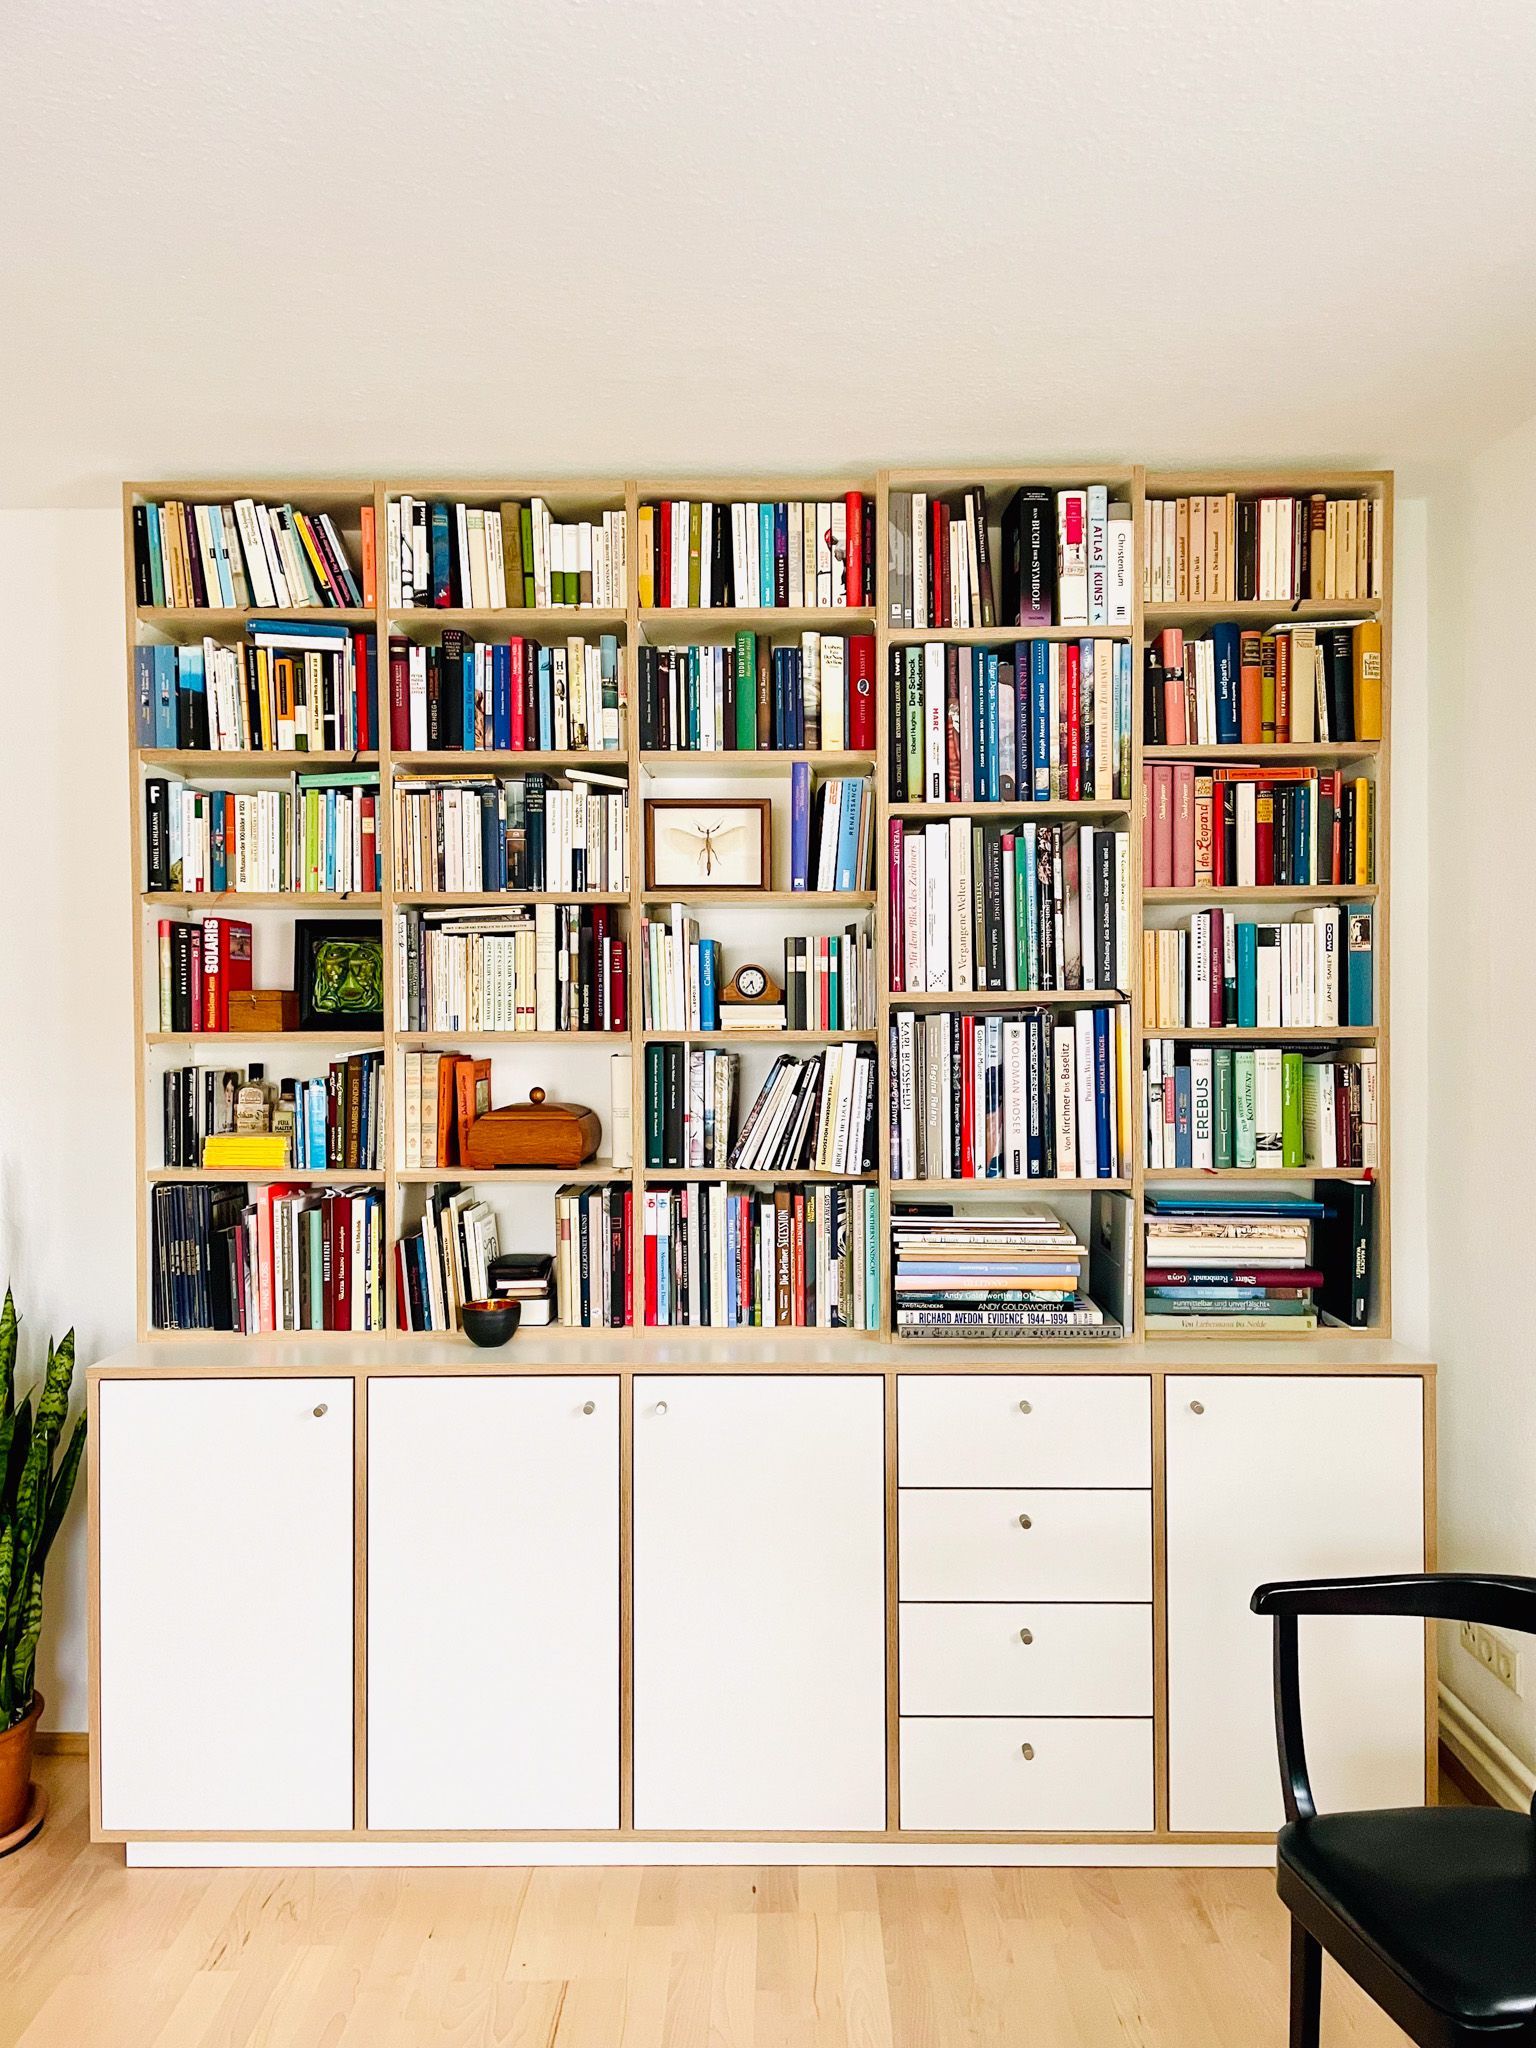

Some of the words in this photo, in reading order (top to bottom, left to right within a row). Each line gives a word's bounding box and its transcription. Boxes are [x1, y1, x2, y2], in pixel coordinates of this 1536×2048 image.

[977, 516, 986, 563] PORTRÄTMALEREI
[1031, 520, 1040, 549] BUCH
[1094, 526, 1103, 561] ATLAS
[1117, 533, 1125, 587] Christentum
[1031, 561, 1040, 611] SYMBOLE
[1094, 572, 1103, 607] KUNST
[989, 661, 997, 680] Edgar
[1019, 655, 1027, 701] TURNER
[1099, 654, 1108, 704] ZEICHENKUNST
[1220, 659, 1229, 699] Landpartie
[910, 710, 918, 734] Hughes
[1020, 702, 1027, 710] IN
[1099, 707, 1108, 719] DER
[1020, 713, 1028, 770] DEUTSCHLAND
[849, 783, 857, 836] RENAISSANCE
[1159, 784, 1168, 820] Shakespeare
[1181, 783, 1190, 820] Shakespeare
[1195, 803, 1212, 852] Leopard
[893, 829, 901, 866] VERMEER
[1196, 853, 1210, 867] der
[908, 845, 917, 887] Zeichners
[908, 888, 917, 903] des
[956, 878, 966, 912] Welten
[976, 881, 984, 923] STILLEBEN
[908, 905, 918, 928] Blick
[203, 920, 219, 974] SOLARIS
[909, 930, 918, 949] dem
[957, 914, 969, 969] Vergangene
[909, 950, 919, 969] Mit
[207, 977, 215, 992] Lem
[207, 992, 215, 1029] Stanislaw
[901, 1021, 910, 1047] KARL
[868, 1059, 876, 1079] Edward
[891, 1035, 899, 1077] Goldsworthy
[1011, 1040, 1019, 1095] KOLOMAN
[1060, 1043, 1070, 1080] Baselitz
[902, 1052, 911, 1110] BLOSSFELDT
[930, 1063, 939, 1093] Regina
[824, 1097, 832, 1126] MODERNEN
[930, 1095, 939, 1127] Relang
[1196, 1078, 1209, 1140] EREBUS
[1237, 1095, 1245, 1119] WEISSE
[1245, 1071, 1254, 1121] KONTINENT
[351, 1105, 359, 1134] BAMBIS
[1012, 1097, 1021, 1135] MOSER
[1062, 1094, 1071, 1135] Kirchner
[1241, 1119, 1249, 1133] DER
[821, 1127, 829, 1166] HOLZSCHNITTS
[776, 1209, 790, 1248] SECESSION
[581, 1235, 589, 1279] GEZEICHNETE
[779, 1248, 789, 1275] Berliner
[261, 1262, 269, 1288] KLOSS
[779, 1275, 789, 1285] Die
[1167, 1273, 1187, 1284] Goya
[1192, 1275, 1229, 1284] Rembrandt
[1235, 1275, 1257, 1285] Dürer
[261, 1289, 269, 1311] HANS
[944, 1292, 965, 1300] Andy
[966, 1292, 1013, 1300] Goldsworthy
[977, 1303, 1001, 1311] ANDY
[1001, 1303, 1065, 1312] GOLDSWORTHY
[918, 1313, 951, 1324] RICHARD
[953, 1312, 984, 1324] AVEDON
[987, 1312, 1024, 1324] EVIDENCE
[1181, 1320, 1194, 1328] Von
[1246, 1320, 1266, 1328] Nolde
